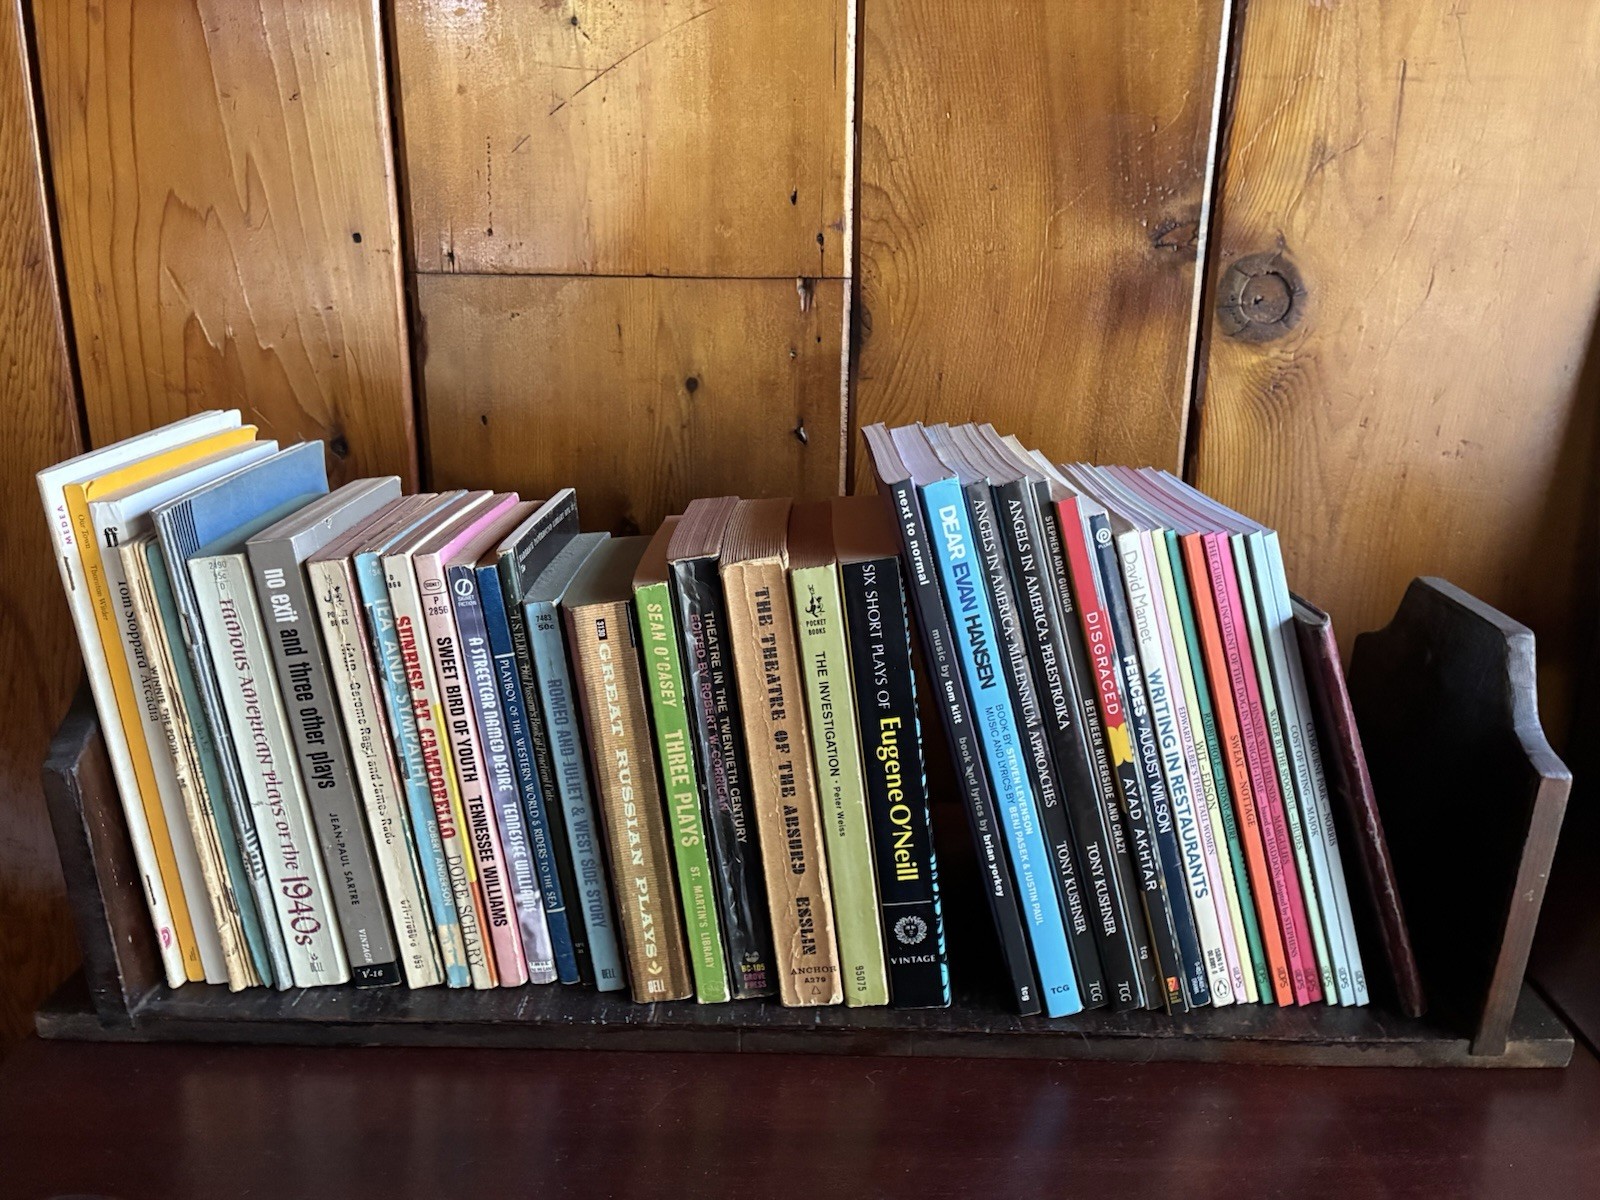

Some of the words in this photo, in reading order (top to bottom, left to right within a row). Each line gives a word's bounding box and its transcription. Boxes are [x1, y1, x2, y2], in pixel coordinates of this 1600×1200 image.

[897, 489, 912, 519] next
[58, 504, 72, 545] MEDEA
[905, 522, 916, 536] to
[939, 504, 966, 560] DEAR
[973, 498, 995, 551] ANGELS
[1007, 498, 1030, 551] ANGELS
[264, 566, 287, 590] no
[861, 564, 876, 586] SIX
[910, 539, 929, 585] normal
[986, 553, 1000, 571] IN
[1020, 554, 1034, 571] IN
[1045, 515, 1059, 552] STEPHEN
[1053, 554, 1063, 574] ADLY
[1058, 577, 1071, 612] GUIRGIS
[1122, 550, 1144, 591] David
[952, 562, 977, 611] EVAN
[270, 591, 298, 625] exit
[647, 602, 665, 641] SEAN
[754, 586, 772, 626] THE
[806, 618, 826, 626] POCKET
[863, 590, 883, 639] SHORT
[990, 572, 1016, 640] AMERICA:
[1024, 573, 1050, 641] AMERICA:
[1132, 594, 1154, 643] Mamet
[280, 626, 307, 658] and
[468, 636, 483, 646] A
[704, 611, 720, 667] THEATRE
[808, 628, 826, 636] BOOKS
[931, 628, 946, 662] music
[396, 615, 424, 691] SUNRISE
[436, 636, 458, 682] SWEET
[815, 651, 826, 676] THE
[870, 644, 888, 685] PLAYS
[965, 614, 995, 689] HANSEN
[1085, 611, 1119, 715] DISGRACED
[288, 660, 318, 702] three
[471, 647, 496, 708] STREETCAR
[654, 645, 676, 708] O'CASEY
[712, 670, 723, 684] IN
[760, 632, 785, 720] THEATRE
[939, 664, 950, 678] by
[1007, 642, 1037, 727] MILLENNIUM
[1040, 643, 1070, 729] PERESTROIKA
[1123, 655, 1146, 716] FENCES
[139, 673, 159, 722] Arcadia
[412, 696, 430, 722] AT
[445, 684, 465, 716] BIRD
[547, 678, 568, 725] ROMEO
[715, 688, 727, 712] THE
[876, 689, 890, 710] OF
[944, 680, 956, 701] tom
[1147, 668, 1175, 748] WRITING
[299, 705, 328, 747] other
[452, 719, 469, 738] OF
[483, 710, 504, 753] NAMED
[818, 681, 839, 776] INVESTIGATION
[950, 704, 962, 723] kitt
[985, 706, 998, 738] MUSIC
[996, 704, 1008, 733] BOOK
[1084, 699, 1100, 745] BETWEEN
[1178, 706, 1190, 741] EDWARD
[1268, 709, 1280, 736] WATER
[557, 729, 573, 756] AND
[719, 716, 737, 784] TWENTIETH
[774, 729, 789, 754] OF
[993, 739, 1003, 759] AND
[1002, 734, 1012, 746] BY
[1274, 738, 1283, 749] BY
[1290, 724, 1300, 748] COST
[306, 749, 339, 791] plays
[456, 738, 478, 782] YOUTH
[493, 753, 512, 791] DESIRE
[665, 729, 689, 786] THREE
[872, 716, 911, 802] Eugene
[1006, 748, 1020, 783] STEVEN
[1028, 730, 1056, 807] APPROACHES
[1096, 748, 1113, 800] RIVERSIDE
[1165, 752, 1180, 771] IN
[1277, 750, 1286, 766] THE
[1294, 749, 1304, 763] OF
[419, 727, 455, 839] CAMPOBELLO
[563, 759, 582, 802] JULIET
[778, 760, 794, 797] THE
[998, 760, 1011, 791] LYRICS
[1137, 726, 1159, 780] AUGUST
[1149, 781, 1170, 833] WILSON
[1192, 777, 1203, 804] THREE
[1195, 741, 1205, 761] WIT
[1201, 772, 1216, 810] EDSON
[1230, 734, 1243, 768] SWEAT
[1239, 781, 1255, 827] NOTTAGE
[1281, 768, 1295, 811] SPOONFUL
[1297, 764, 1309, 795] LIVING
[570, 805, 585, 816] &
[598, 642, 623, 737] GREAT
[615, 748, 643, 867] RUSSIAN
[634, 876, 657, 958] PLAYS
[730, 788, 746, 843] CENTURY
[833, 786, 842, 809] Peter
[1004, 792, 1015, 804] BY
[1015, 785, 1032, 834] LEVENSON
[1107, 802, 1118, 821] AND
[1198, 804, 1208, 823] TALL
[674, 792, 698, 847] PLAYS
[836, 811, 846, 836] Weiss
[1009, 806, 1020, 829] BENJ
[1121, 777, 1141, 820] AYAD
[1133, 827, 1156, 891] AKHTAR
[1292, 822, 1302, 850] HUDES
[1306, 807, 1318, 836] MAJOK
[574, 820, 592, 855] WEST
[784, 804, 805, 875] ABSURD
[886, 803, 920, 882] O'Neill
[1015, 831, 1028, 861] PASEK
[1112, 823, 1125, 854] CRAZY
[1170, 775, 1208, 899] RESTAURANTS
[1202, 824, 1214, 855] WOMEN
[329, 812, 349, 866] JEAN-PAUL
[344, 870, 358, 905] SARTRE
[427, 820, 440, 853] ROBERT
[435, 857, 450, 906] ANDERSON
[468, 796, 494, 862] TENNESSEE
[482, 866, 507, 927] WILLIAMS
[502, 801, 525, 858] TENNESSEE
[514, 859, 536, 912] WILLIAMS
[580, 858, 597, 885] SIDE
[690, 866, 700, 880] ST.
[1022, 862, 1031, 870] &
[1086, 841, 1104, 878] TONY
[1024, 870, 1037, 901] JUSTIN
[1055, 841, 1073, 877] TONY
[1064, 878, 1087, 934] KUSHNER
[447, 854, 468, 899] DORE
[458, 904, 483, 969] SCHARY
[586, 889, 605, 929] STORY
[693, 886, 707, 928] MARTIN'S
[1032, 903, 1043, 925] PAUL
[1094, 879, 1116, 936] KUSHNER
[357, 928, 372, 964] VINTAGE
[701, 932, 714, 968] LIBRARY
[890, 954, 936, 964] VINTAGE
[790, 965, 837, 975] ANCHOR
[855, 965, 865, 991] 95075
[1050, 984, 1070, 993] TCG
[1088, 981, 1102, 1002] TCG
[1117, 981, 1131, 1002] TCG
